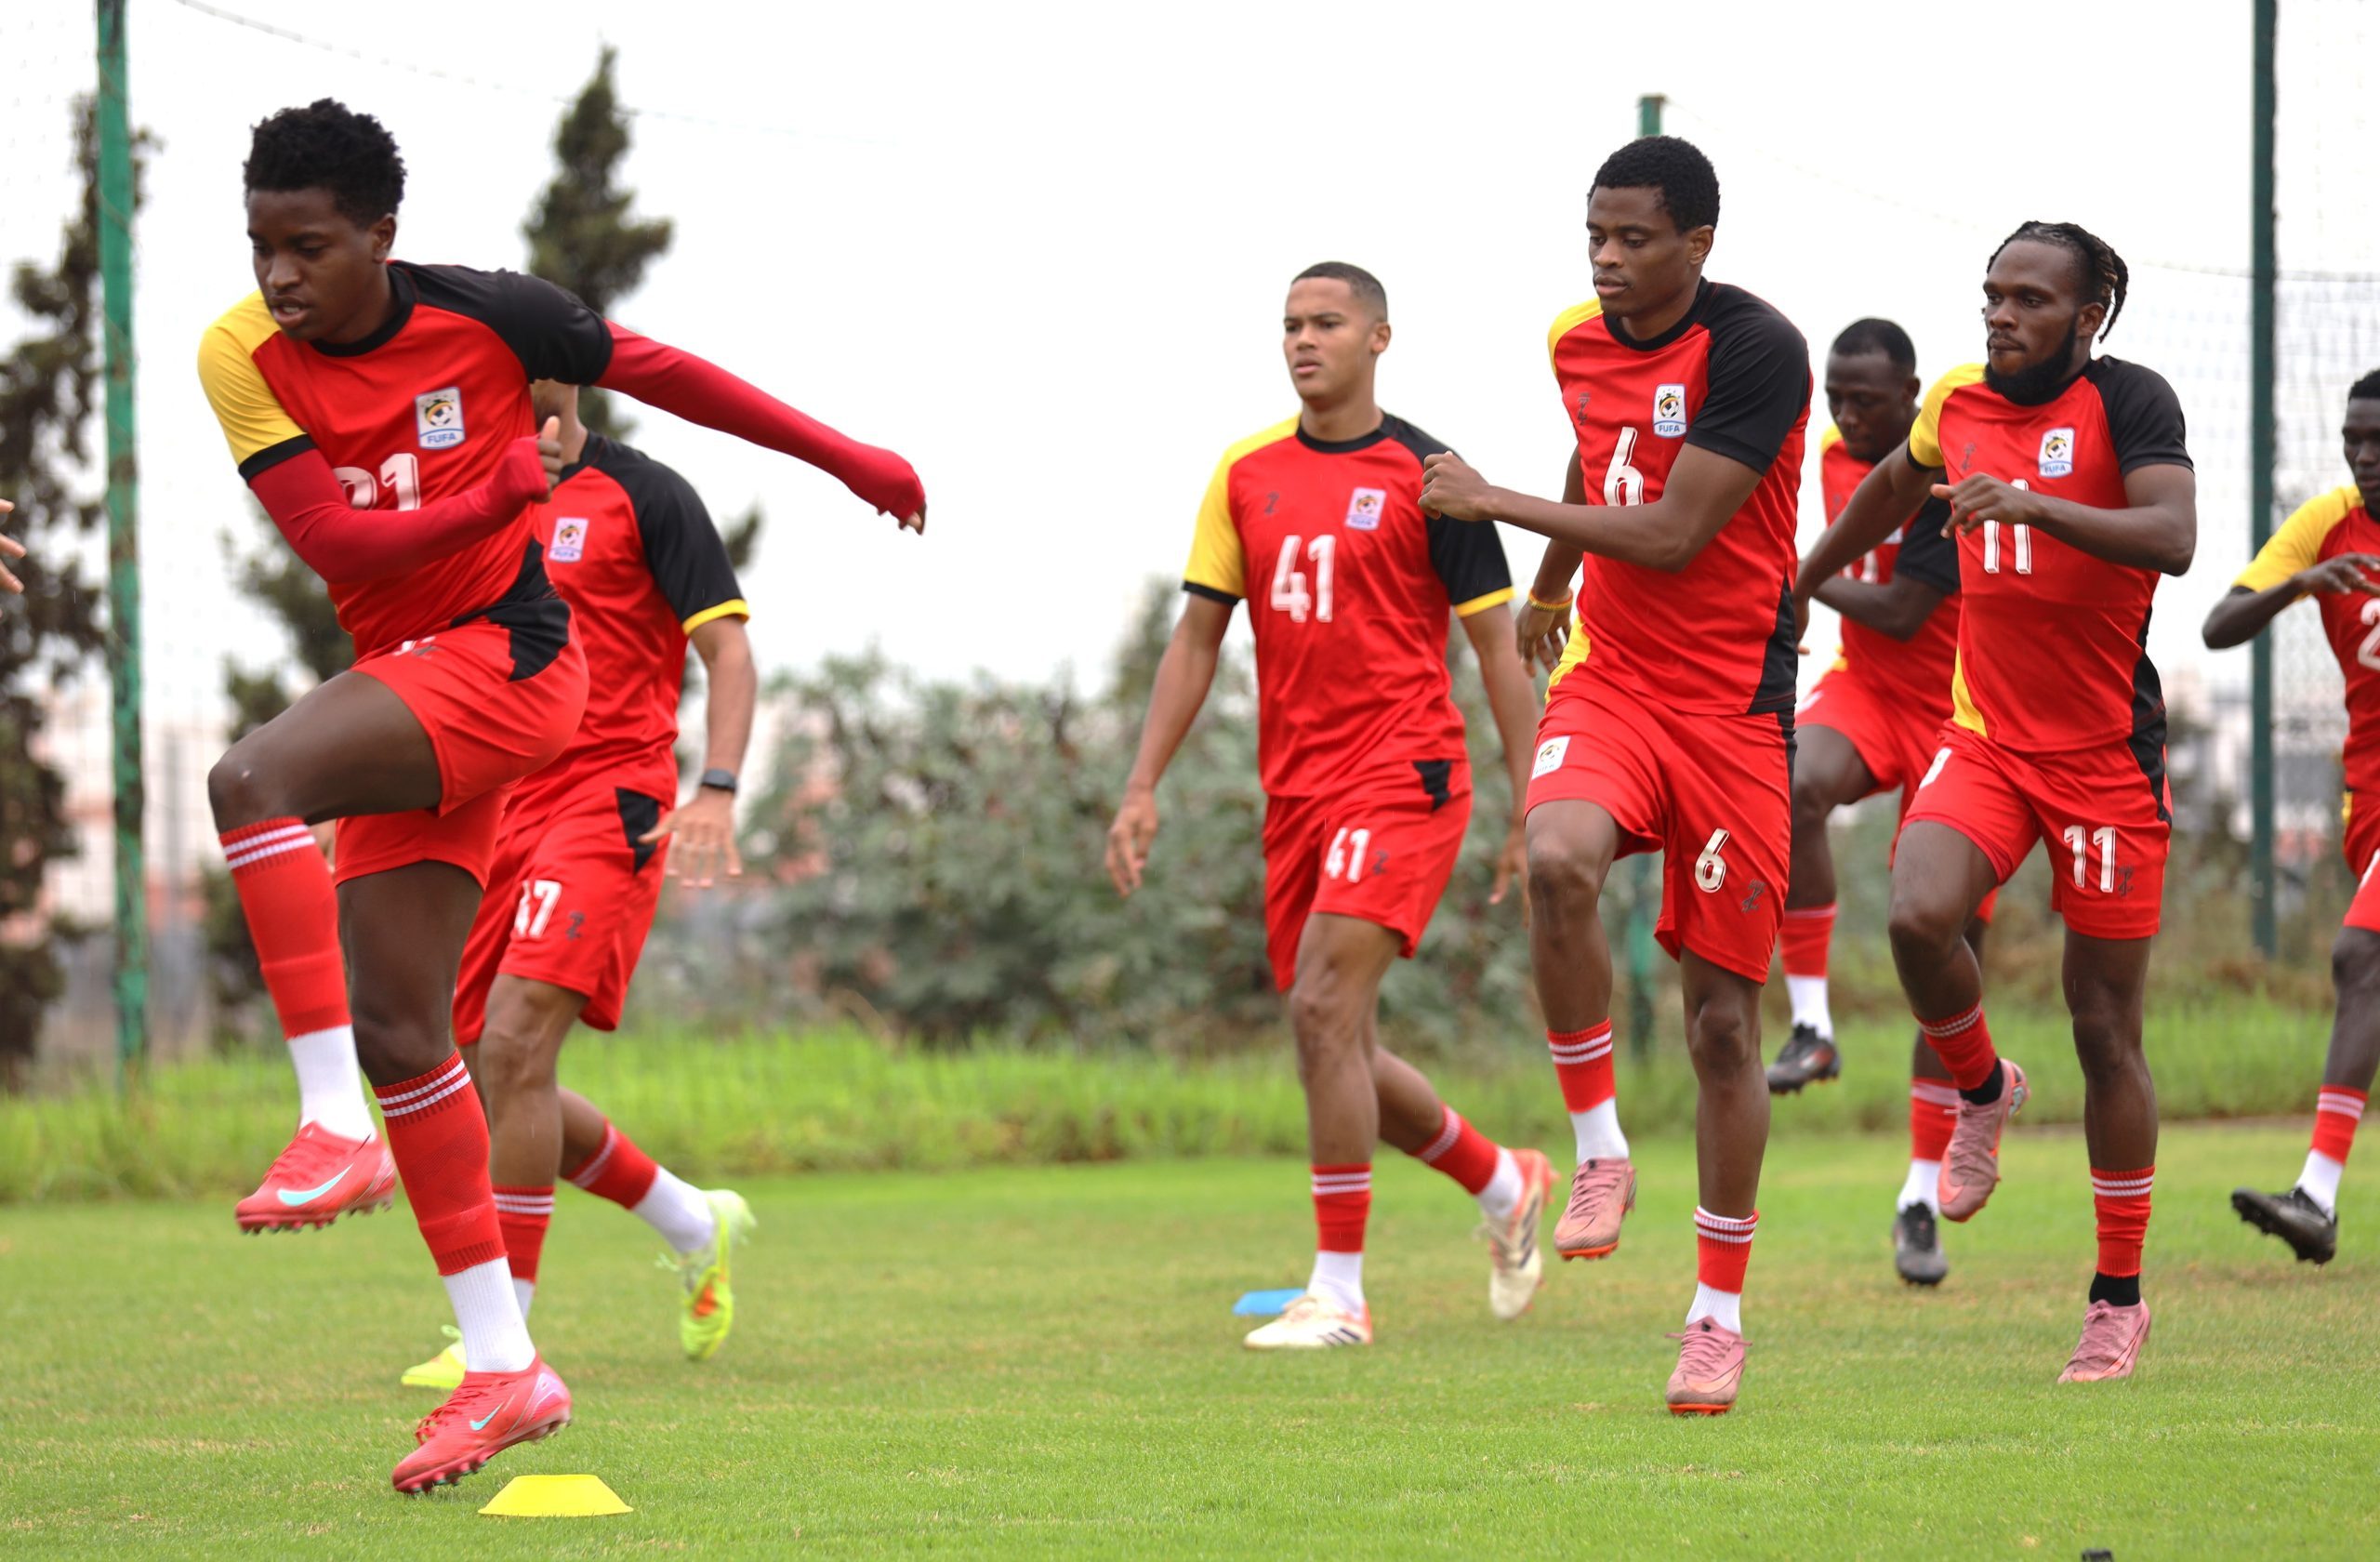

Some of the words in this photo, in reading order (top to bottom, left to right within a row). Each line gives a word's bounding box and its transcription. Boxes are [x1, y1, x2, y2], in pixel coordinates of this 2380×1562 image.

[427, 432, 457, 444] FUFA
[1659, 424, 1680, 432] FUFA
[1604, 426, 1644, 506] 6
[1270, 534, 1337, 623] 41
[1324, 827, 1371, 884] 41
[1695, 827, 1730, 894] 6
[2064, 825, 2116, 893] 11
[513, 879, 563, 941] 17
